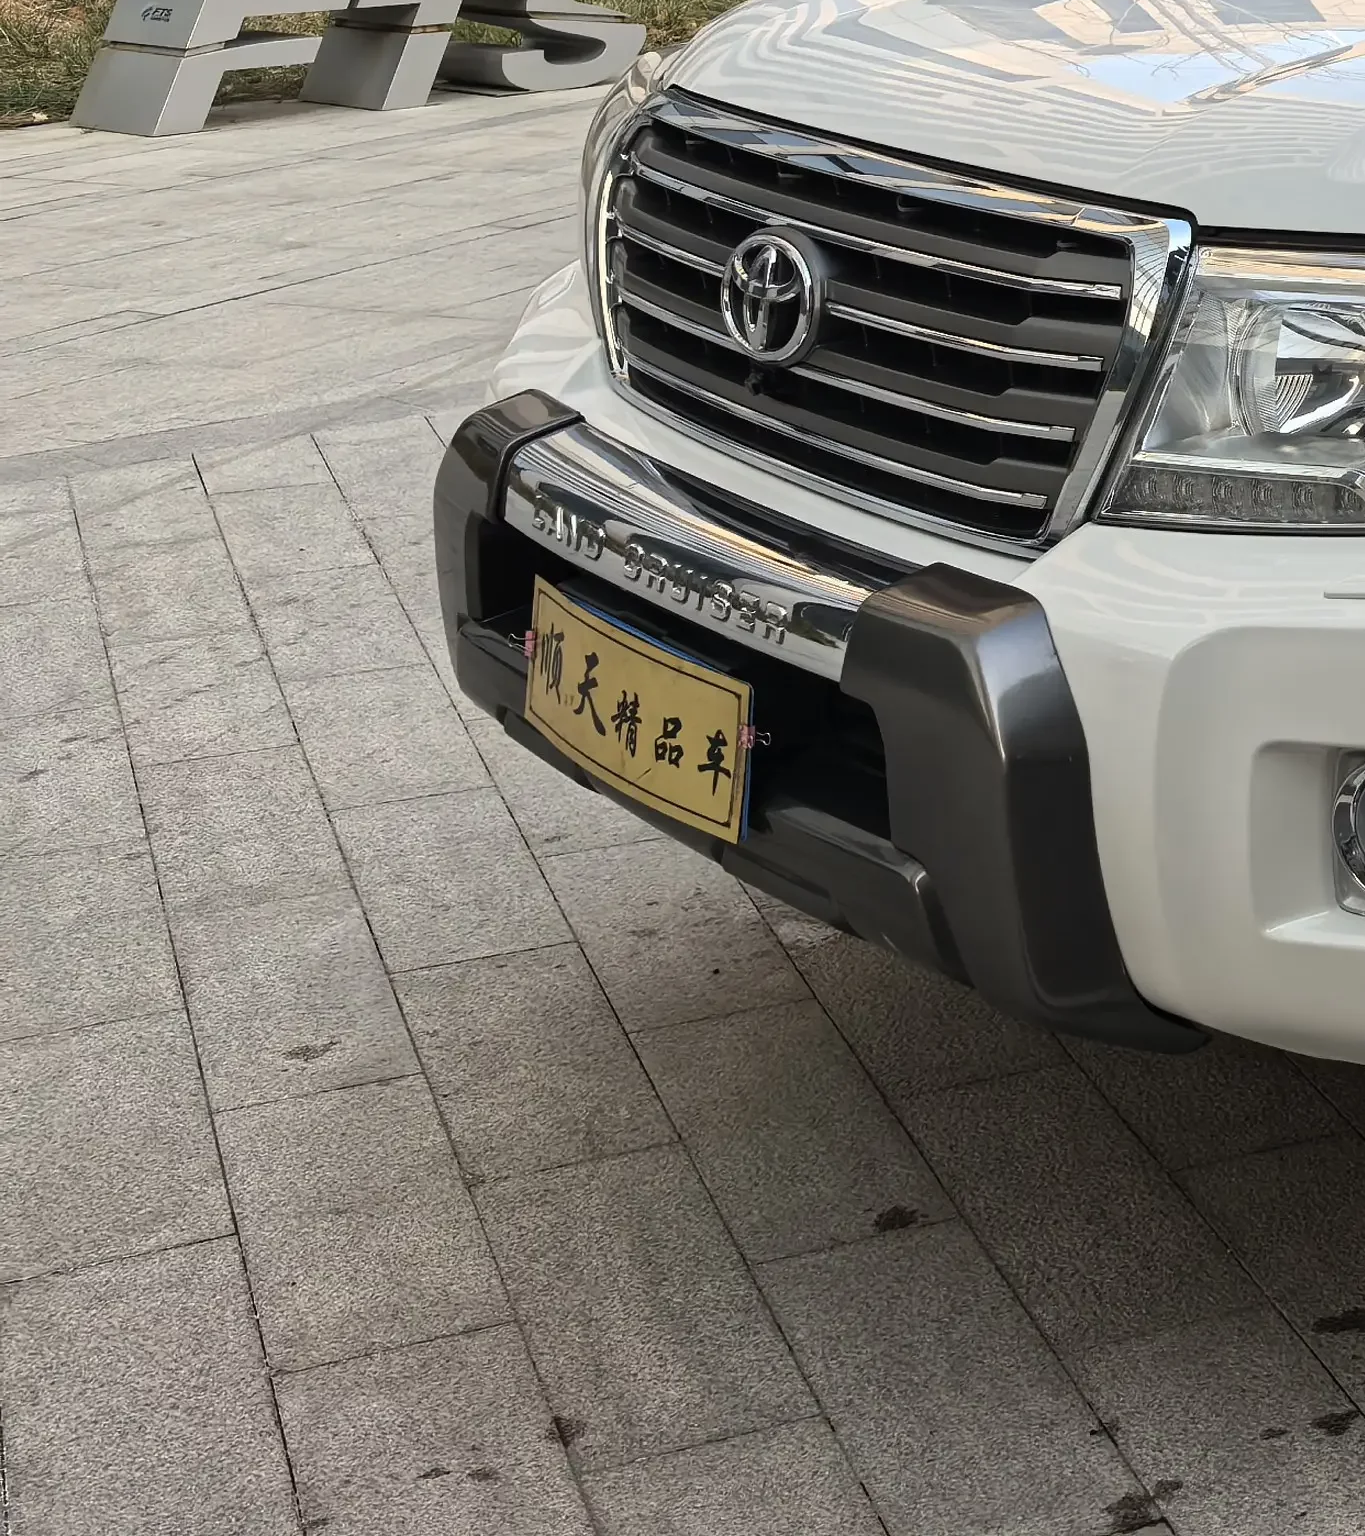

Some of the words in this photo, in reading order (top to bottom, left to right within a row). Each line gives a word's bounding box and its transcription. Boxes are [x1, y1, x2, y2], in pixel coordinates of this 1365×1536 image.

[534, 494, 607, 562] LAND
[623, 542, 789, 646] CRUISER
[541, 622, 732, 797] 顺天精品车
